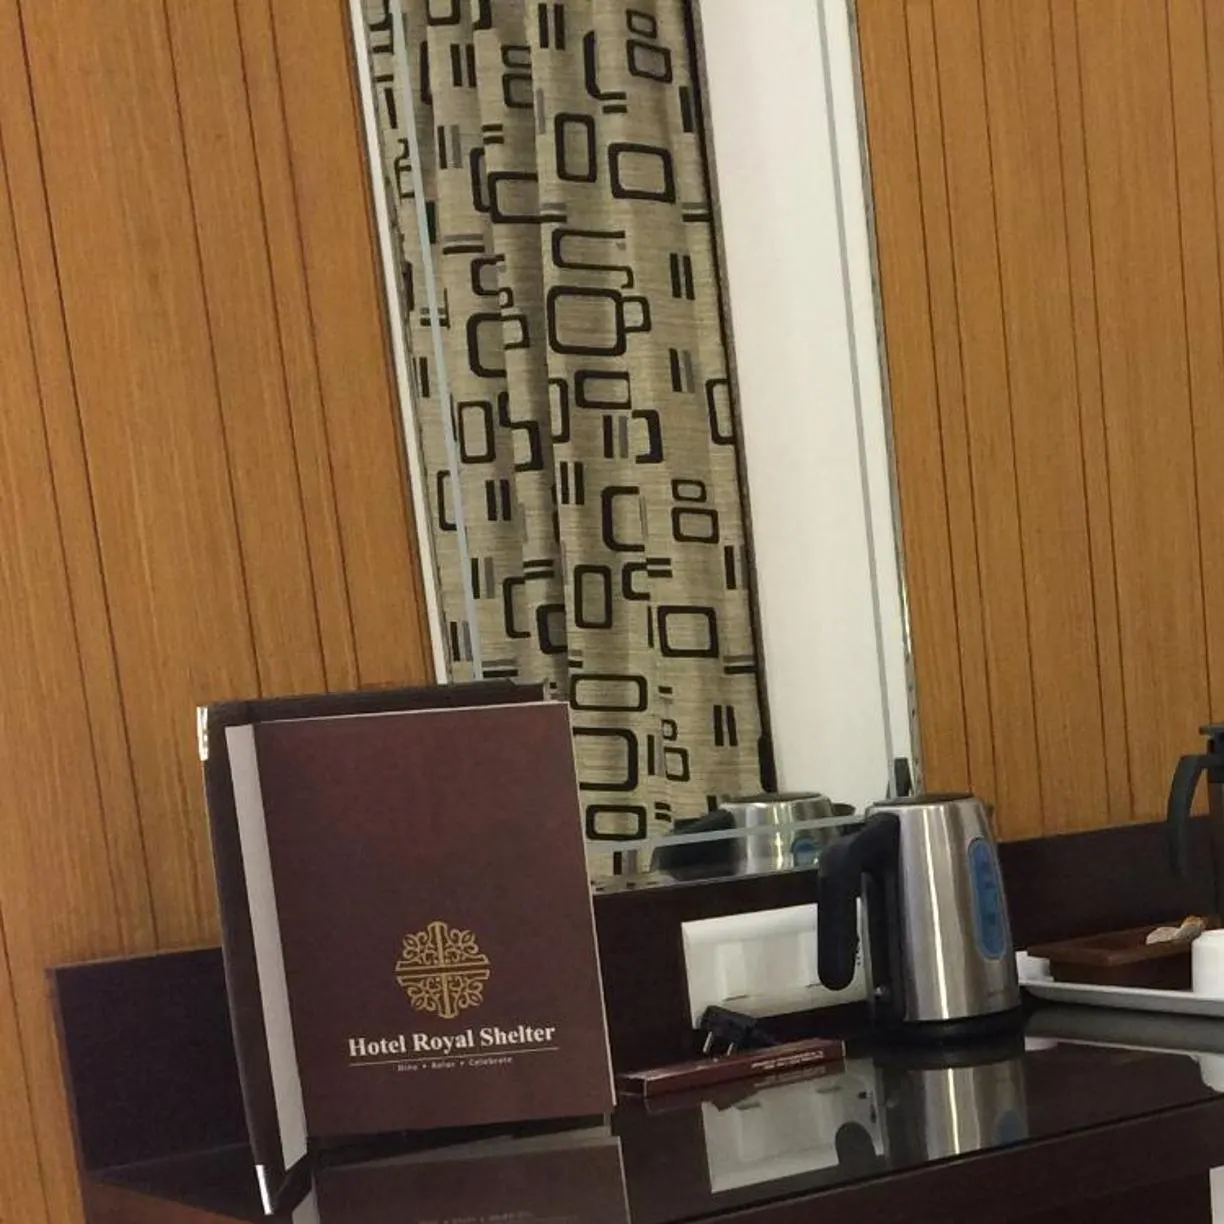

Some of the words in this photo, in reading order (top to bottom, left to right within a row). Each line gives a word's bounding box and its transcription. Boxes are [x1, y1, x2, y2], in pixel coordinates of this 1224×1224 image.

[348, 1034, 406, 1057] Hotel
[412, 1029, 474, 1055] Royal
[480, 1025, 556, 1047] Shelter
